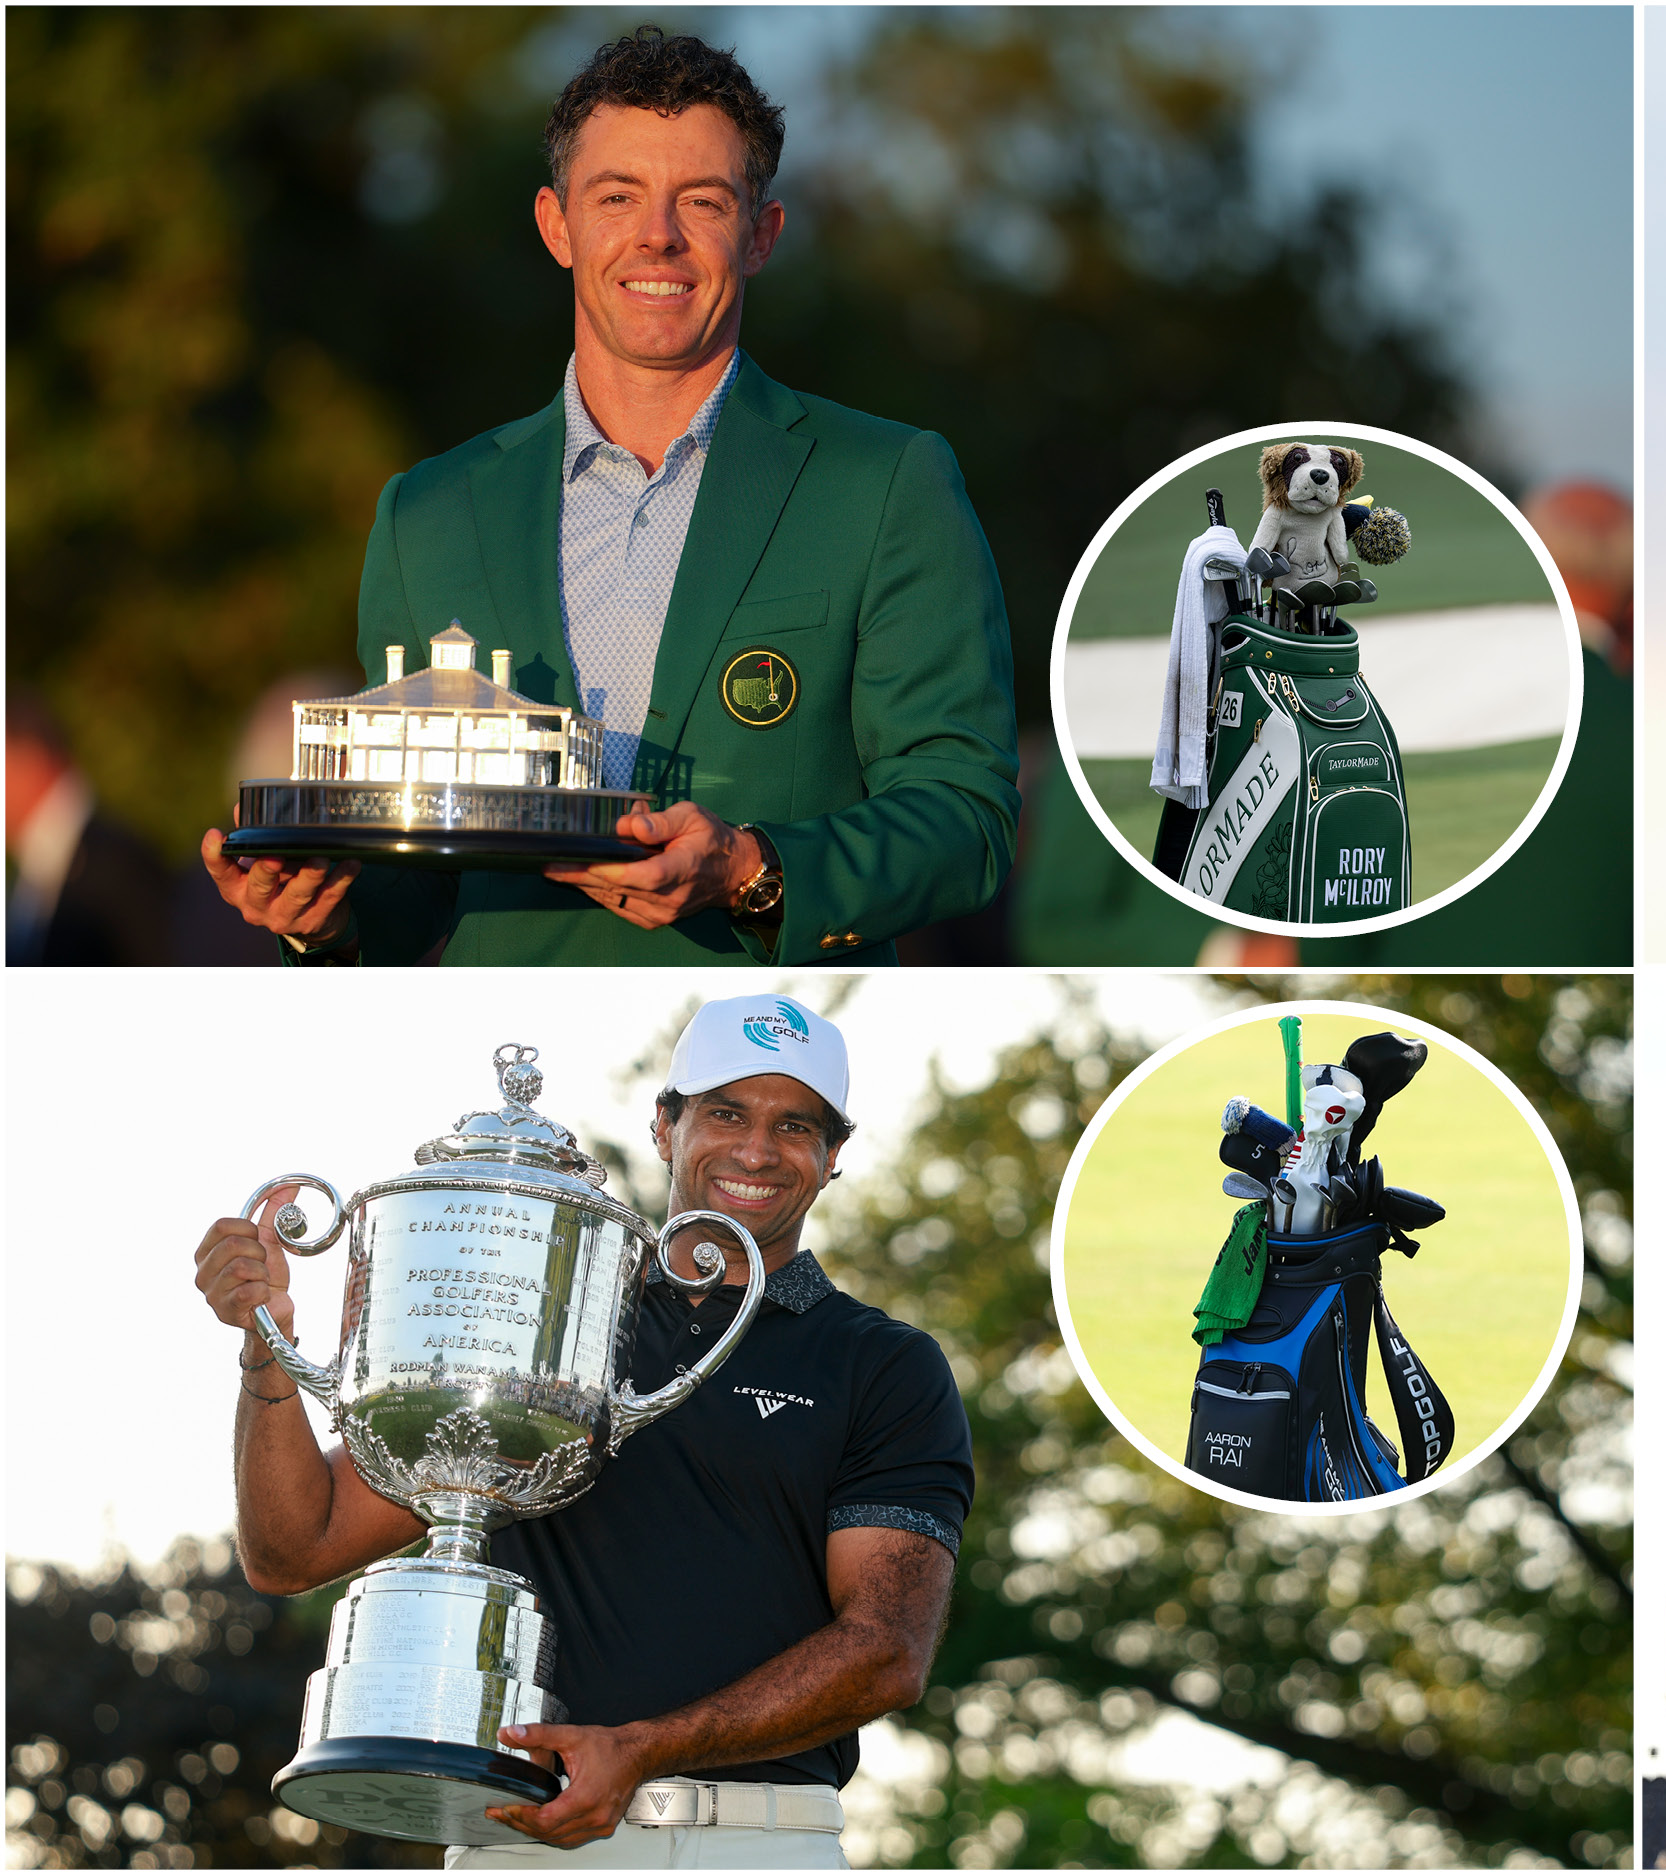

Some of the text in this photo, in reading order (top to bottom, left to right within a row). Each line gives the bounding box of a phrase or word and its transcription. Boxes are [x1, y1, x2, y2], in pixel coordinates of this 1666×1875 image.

[1222, 697, 1238, 721] 26
[1329, 757, 1379, 771] TAYLORMADE
[1339, 847, 1386, 875] RORY
[772, 1026, 810, 1044] GOLF
[1251, 1143, 1265, 1160] 5
[443, 1202, 531, 1221] ANNUAL
[408, 1220, 565, 1247] CHAMPIONSHIP
[458, 1246, 502, 1257] OF THE
[406, 1268, 552, 1297] PROFESSIONAL
[431, 1286, 519, 1306] GOLFERS
[407, 1302, 543, 1328] ASSOCIATION
[422, 1333, 517, 1356] AMERICA
[390, 1361, 448, 1374] RODMAN
[453, 1362, 549, 1387] WANAMAKER
[433, 1375, 495, 1391] TROPHY
[733, 1386, 814, 1407] LEVELWEAR
[1390, 1337, 1441, 1478] TOPGOLF
[1205, 1431, 1252, 1448] AARON
[1209, 1446, 1243, 1467] RAI
